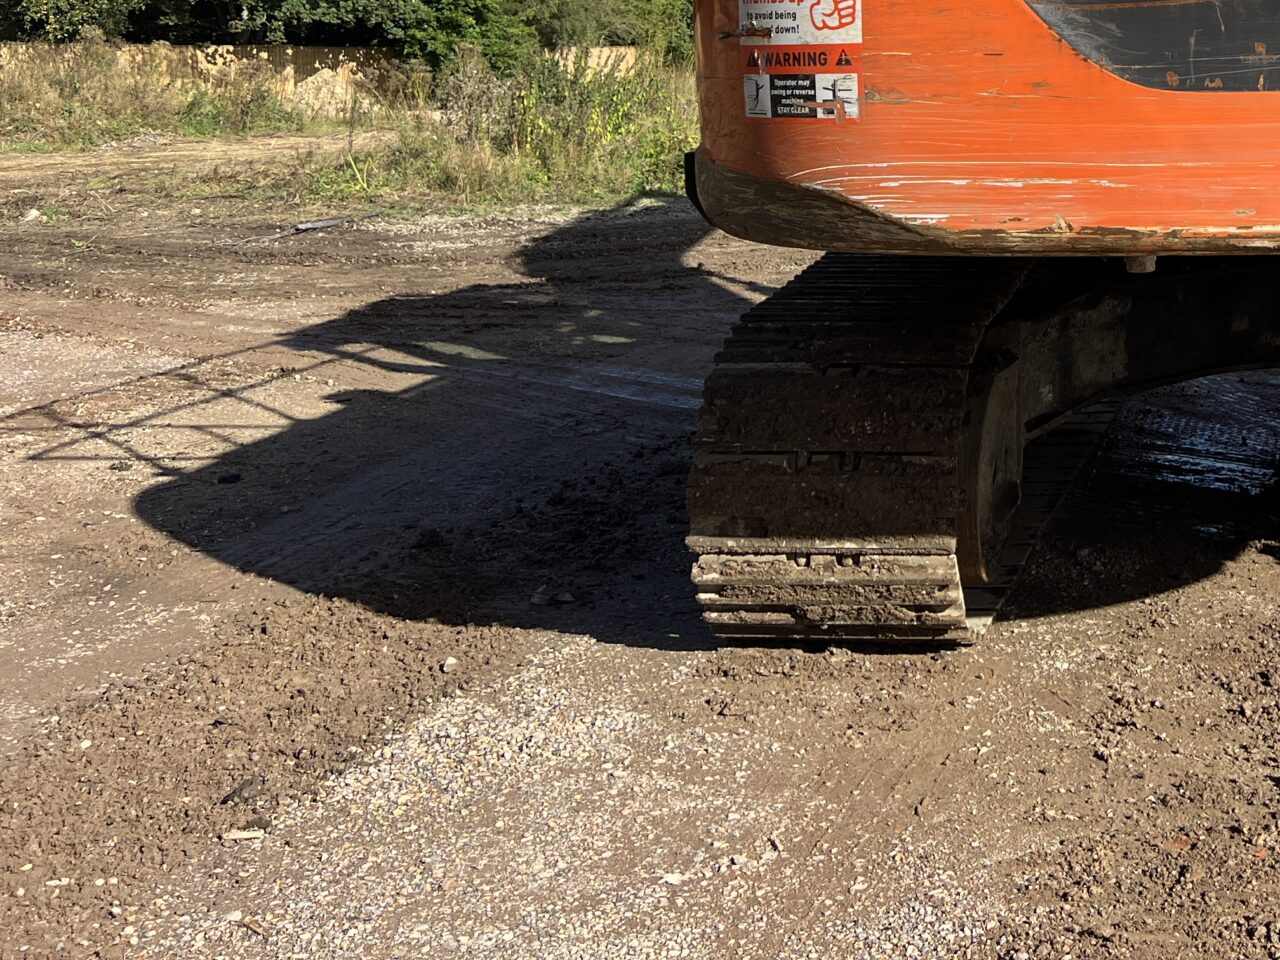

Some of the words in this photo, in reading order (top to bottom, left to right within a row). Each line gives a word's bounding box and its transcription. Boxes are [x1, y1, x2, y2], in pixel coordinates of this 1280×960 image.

[746, 11, 754, 20] to
[754, 11, 773, 20] avoid
[774, 10, 797, 21] being
[774, 24, 800, 34] down!
[764, 51, 828, 67] WARNING
